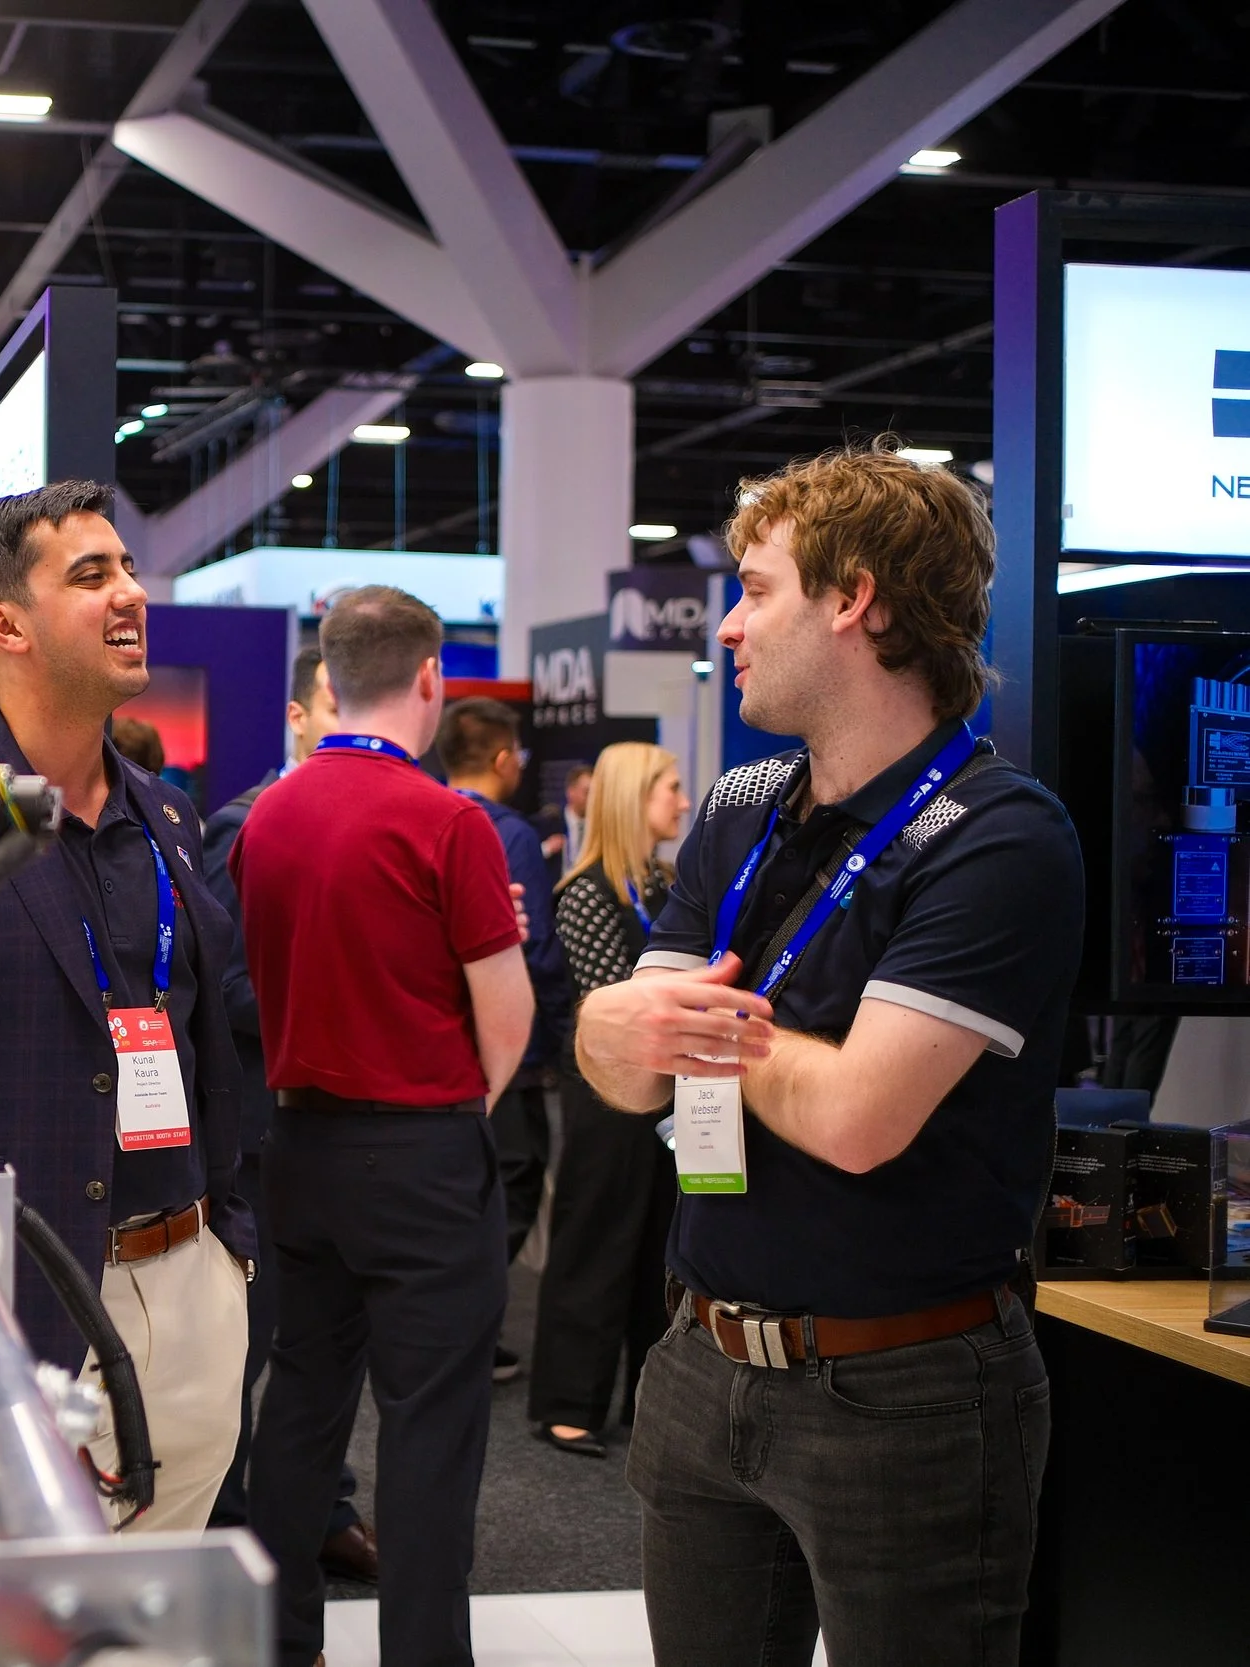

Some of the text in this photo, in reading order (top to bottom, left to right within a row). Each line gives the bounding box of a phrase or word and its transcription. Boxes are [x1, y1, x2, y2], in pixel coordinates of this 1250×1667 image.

[532, 645, 598, 706] MDA
[131, 1054, 156, 1065] Kunal
[134, 1068, 159, 1078] Kaura
[697, 1088, 715, 1100] Jack
[690, 1104, 722, 1115] Webster
[124, 1130, 188, 1143] EXHIBITION BOOTH STAFF
